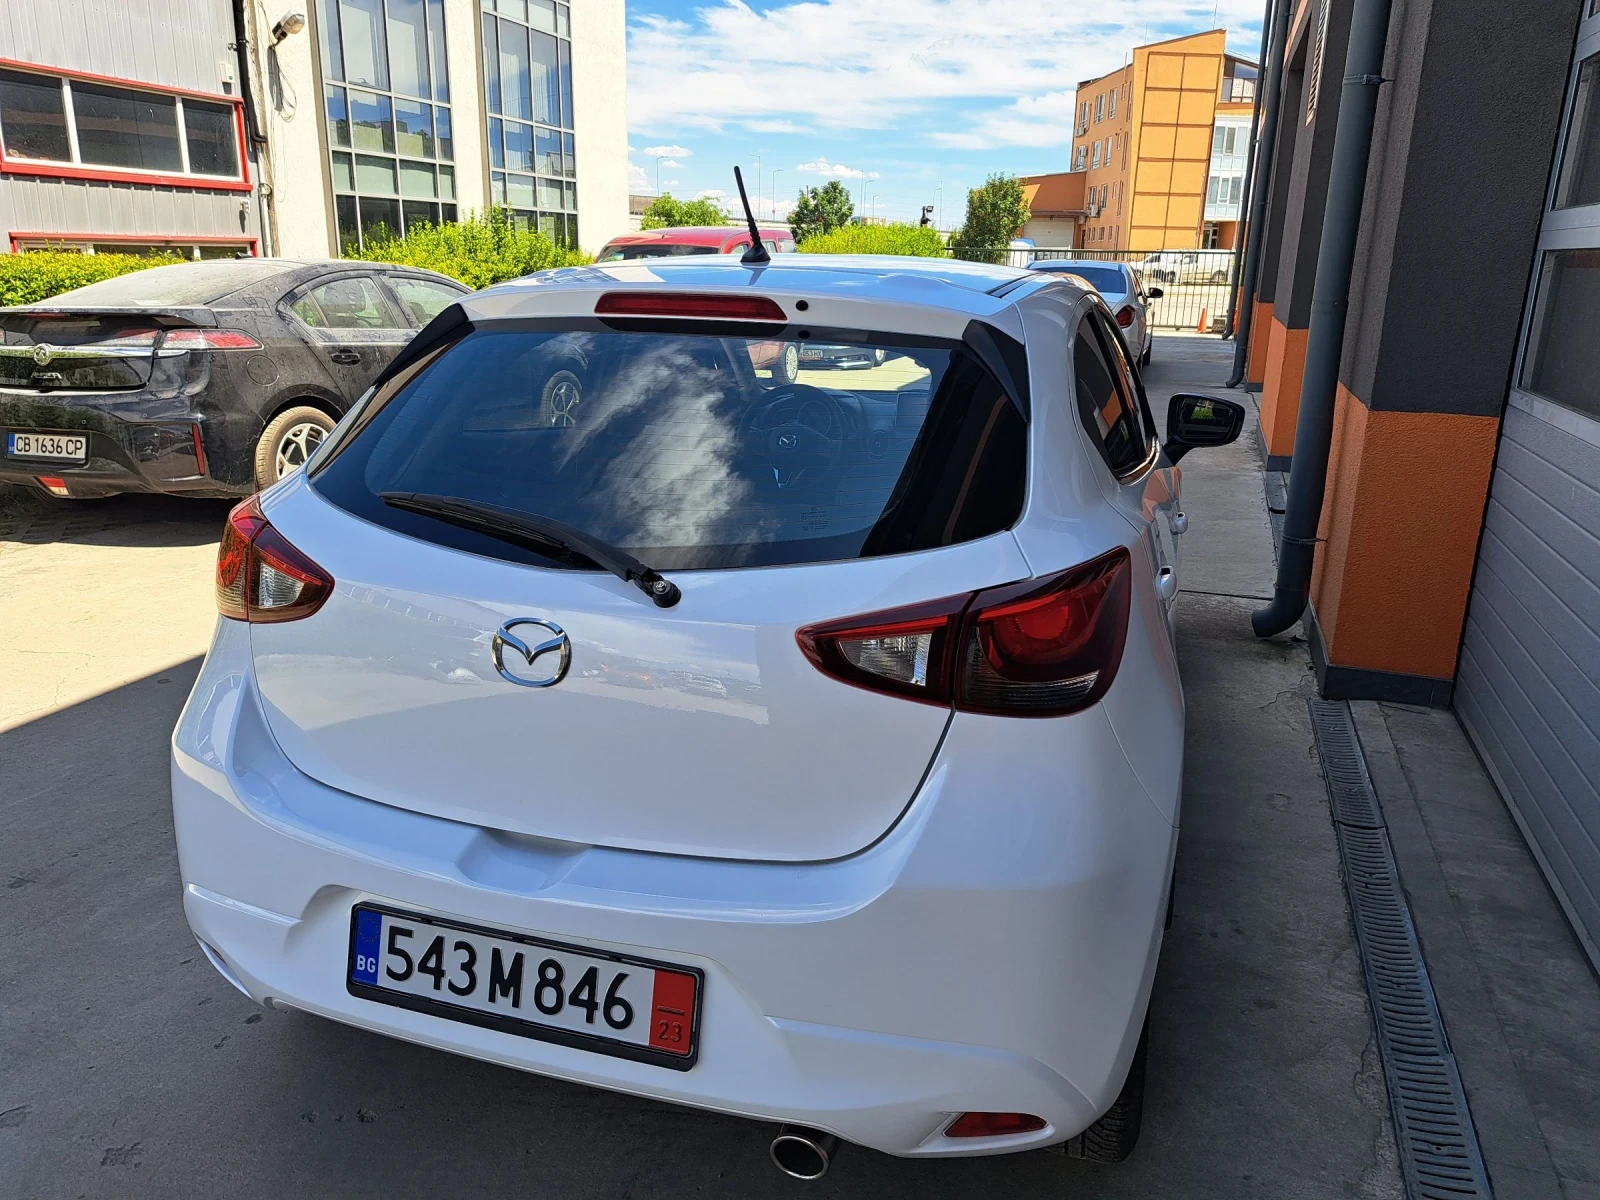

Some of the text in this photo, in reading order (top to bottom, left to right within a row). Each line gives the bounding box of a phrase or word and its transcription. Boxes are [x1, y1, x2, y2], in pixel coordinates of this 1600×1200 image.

[16, 436, 83, 456] CB 1636 CP
[356, 954, 376, 974] BG
[386, 925, 634, 1030] 543 M 846
[658, 1019, 683, 1043] 23
